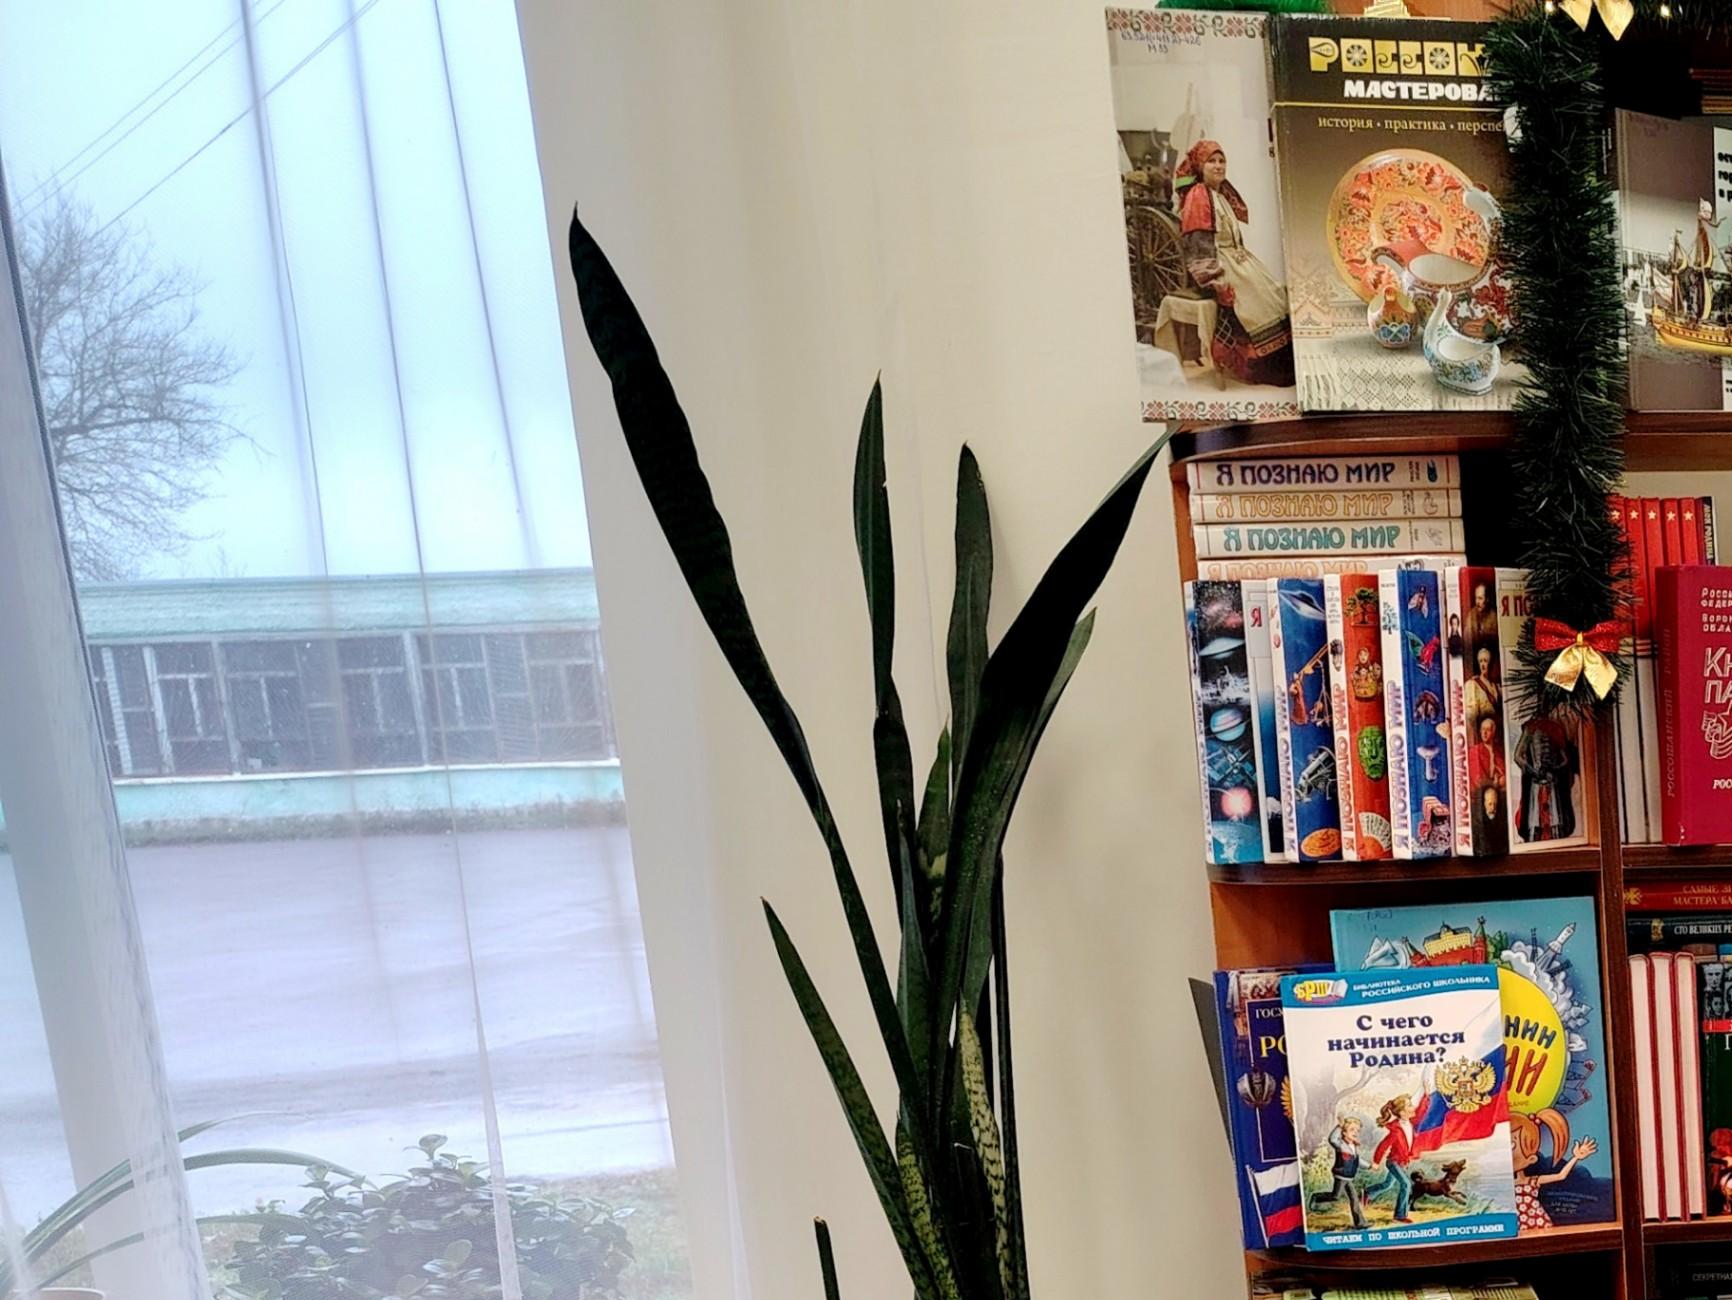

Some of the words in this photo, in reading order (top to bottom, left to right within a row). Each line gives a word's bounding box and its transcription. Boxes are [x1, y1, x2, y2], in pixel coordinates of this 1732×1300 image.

[1344, 81, 1499, 101] МАСТЕРОВА
[1318, 116, 1373, 133] история
[1384, 119, 1446, 132] практика
[1458, 120, 1506, 134] перспе
[1216, 464, 1234, 486] Я
[1240, 463, 1339, 485] ПОЗНАЮ
[1346, 462, 1395, 482] МИР
[1224, 529, 1242, 550] Я
[1247, 528, 1345, 550] ПОЗНАЮ
[1350, 526, 1400, 549] МИР
[1674, 925, 1688, 935] СТО
[1689, 924, 1722, 935] ВЕЛИКИХ
[1362, 981, 1430, 998] РОССИЙСКОГО
[1433, 976, 1490, 987] ШКОЛЬНИКА
[1356, 1015, 1372, 1031] С
[1380, 1014, 1433, 1030] чего
[1327, 1030, 1465, 1052] начинается
[1350, 1047, 1445, 1069] Родина?
[1368, 1232, 1382, 1242] ПО
[1446, 1224, 1505, 1237] ПРОГРАММЕ
